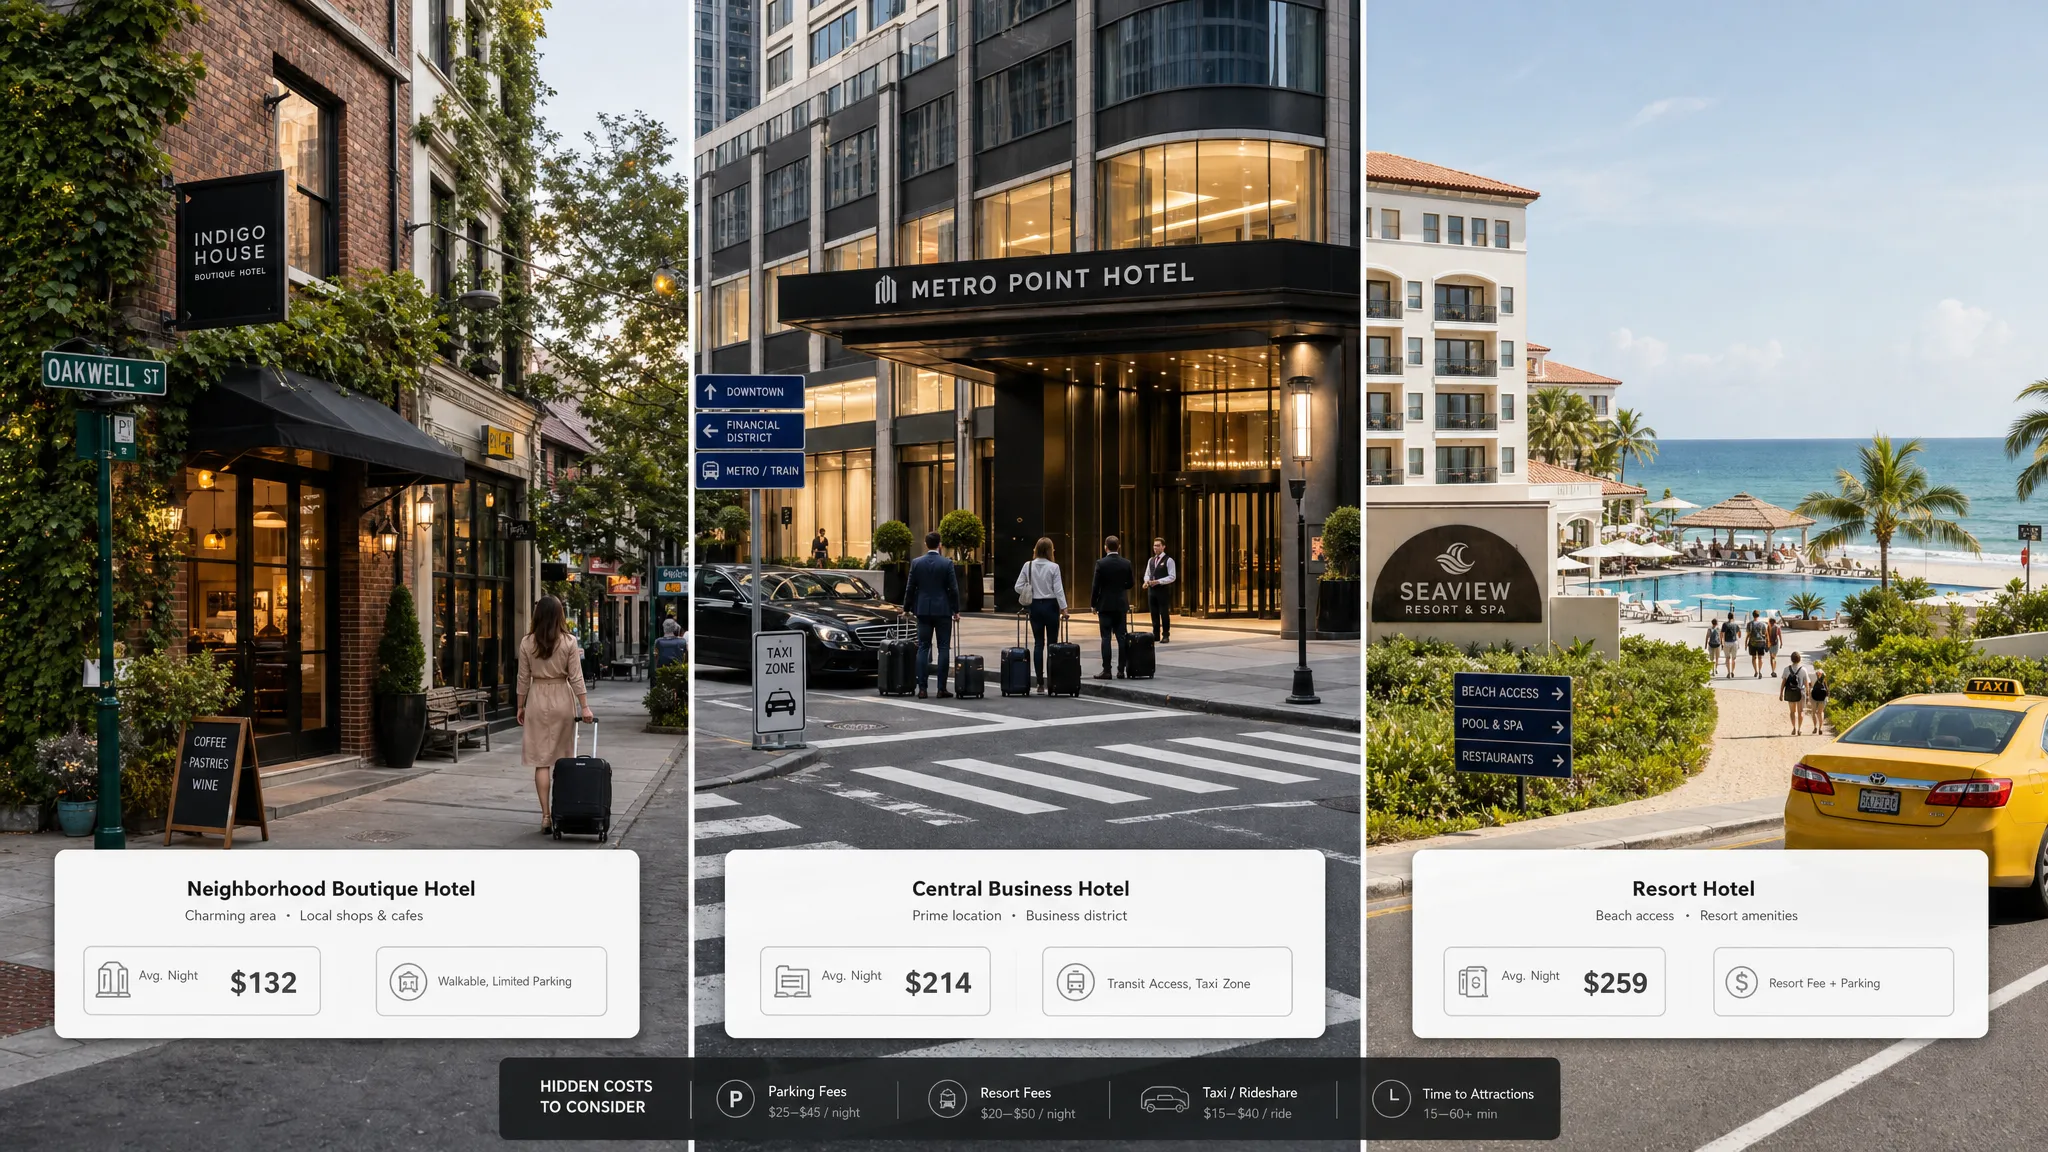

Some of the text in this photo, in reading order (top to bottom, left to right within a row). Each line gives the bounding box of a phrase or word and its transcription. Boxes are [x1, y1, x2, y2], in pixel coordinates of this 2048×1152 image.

[195, 225, 265, 246] INDIGO
[195, 244, 264, 265] HOUSE
[195, 268, 265, 280] BOUTIQUE HOTEL
[913, 263, 1194, 298] METRO POINT HOTEL
[48, 358, 159, 387] OAKWELL ST
[727, 387, 783, 396] DOWNTOWN
[727, 421, 780, 429] FINANCIAL
[728, 433, 772, 442] DISTRICT
[727, 466, 798, 476] METRO / TRAIN
[1401, 582, 1510, 600] SEAVIEW
[1406, 605, 1505, 614] RESORT & SPA
[767, 647, 791, 658] TAXI
[766, 662, 795, 674] ZONE
[1462, 686, 1539, 698] BEACH ACCESS
[1974, 681, 2009, 693] TAXI
[1463, 718, 1523, 730] POOL & SPA
[194, 736, 227, 748] COFFEE
[189, 757, 228, 769] PASTRIES
[1463, 751, 1533, 764] RESTAURANTS
[193, 779, 218, 790] WINE
